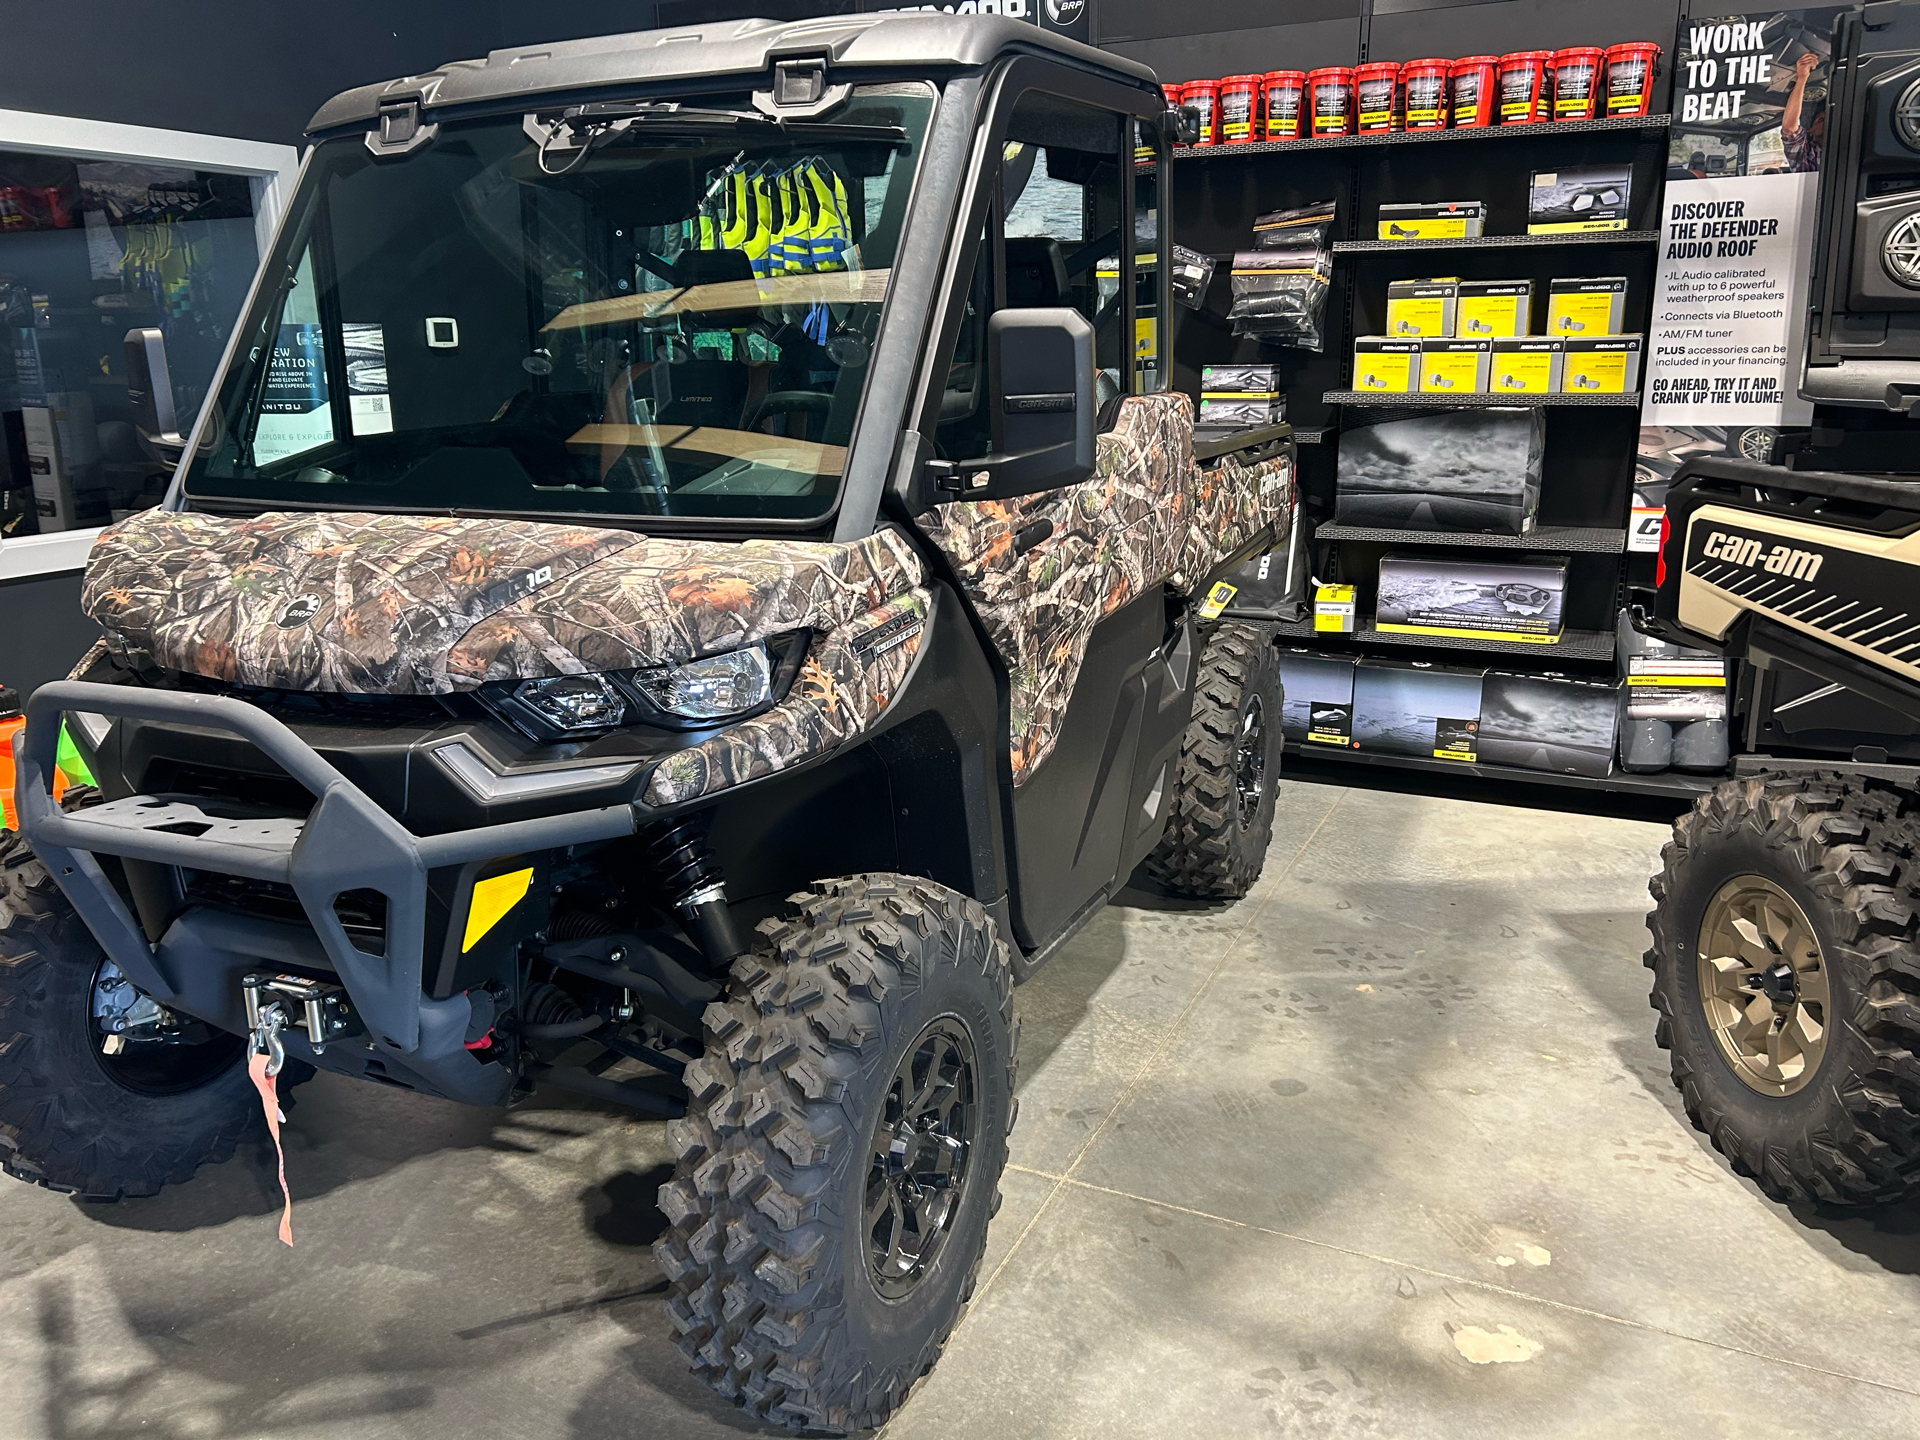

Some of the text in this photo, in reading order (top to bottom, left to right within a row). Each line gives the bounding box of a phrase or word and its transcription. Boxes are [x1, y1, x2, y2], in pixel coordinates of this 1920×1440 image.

[1061, 0, 1082, 11] BRP
[1689, 21, 1767, 55] WORK
[1686, 54, 1773, 89] TO THE
[1682, 90, 1746, 122] BEAT
[1671, 201, 1745, 221] DISCOVER
[1669, 219, 1779, 239] THE DEFENDER
[1666, 240, 1758, 259] AUDIO ROOF
[1681, 271, 1712, 280] Audio
[1714, 268, 1766, 279] calibrated
[1668, 280, 1776, 295] with up to 6 powerful
[1666, 291, 1785, 304] weatherproof speakers
[1665, 310, 1783, 321] Connects via Bluetooth
[1663, 330, 1733, 339] AM/FM tuner
[274, 348, 290, 357] EW
[1657, 345, 1787, 355] PLUS accessories can be
[1655, 356, 1789, 367] included in your financing.
[1653, 377, 1777, 392] GO AHEAD, TRY IT AND
[1018, 399, 1065, 409] can-am
[1651, 391, 1784, 404] CRANK UP THE VOLUME!
[1259, 467, 1289, 495] can-am
[1703, 531, 1824, 583] can-am
[288, 609, 314, 618] BRP
[878, 626, 919, 652] LIMITED
